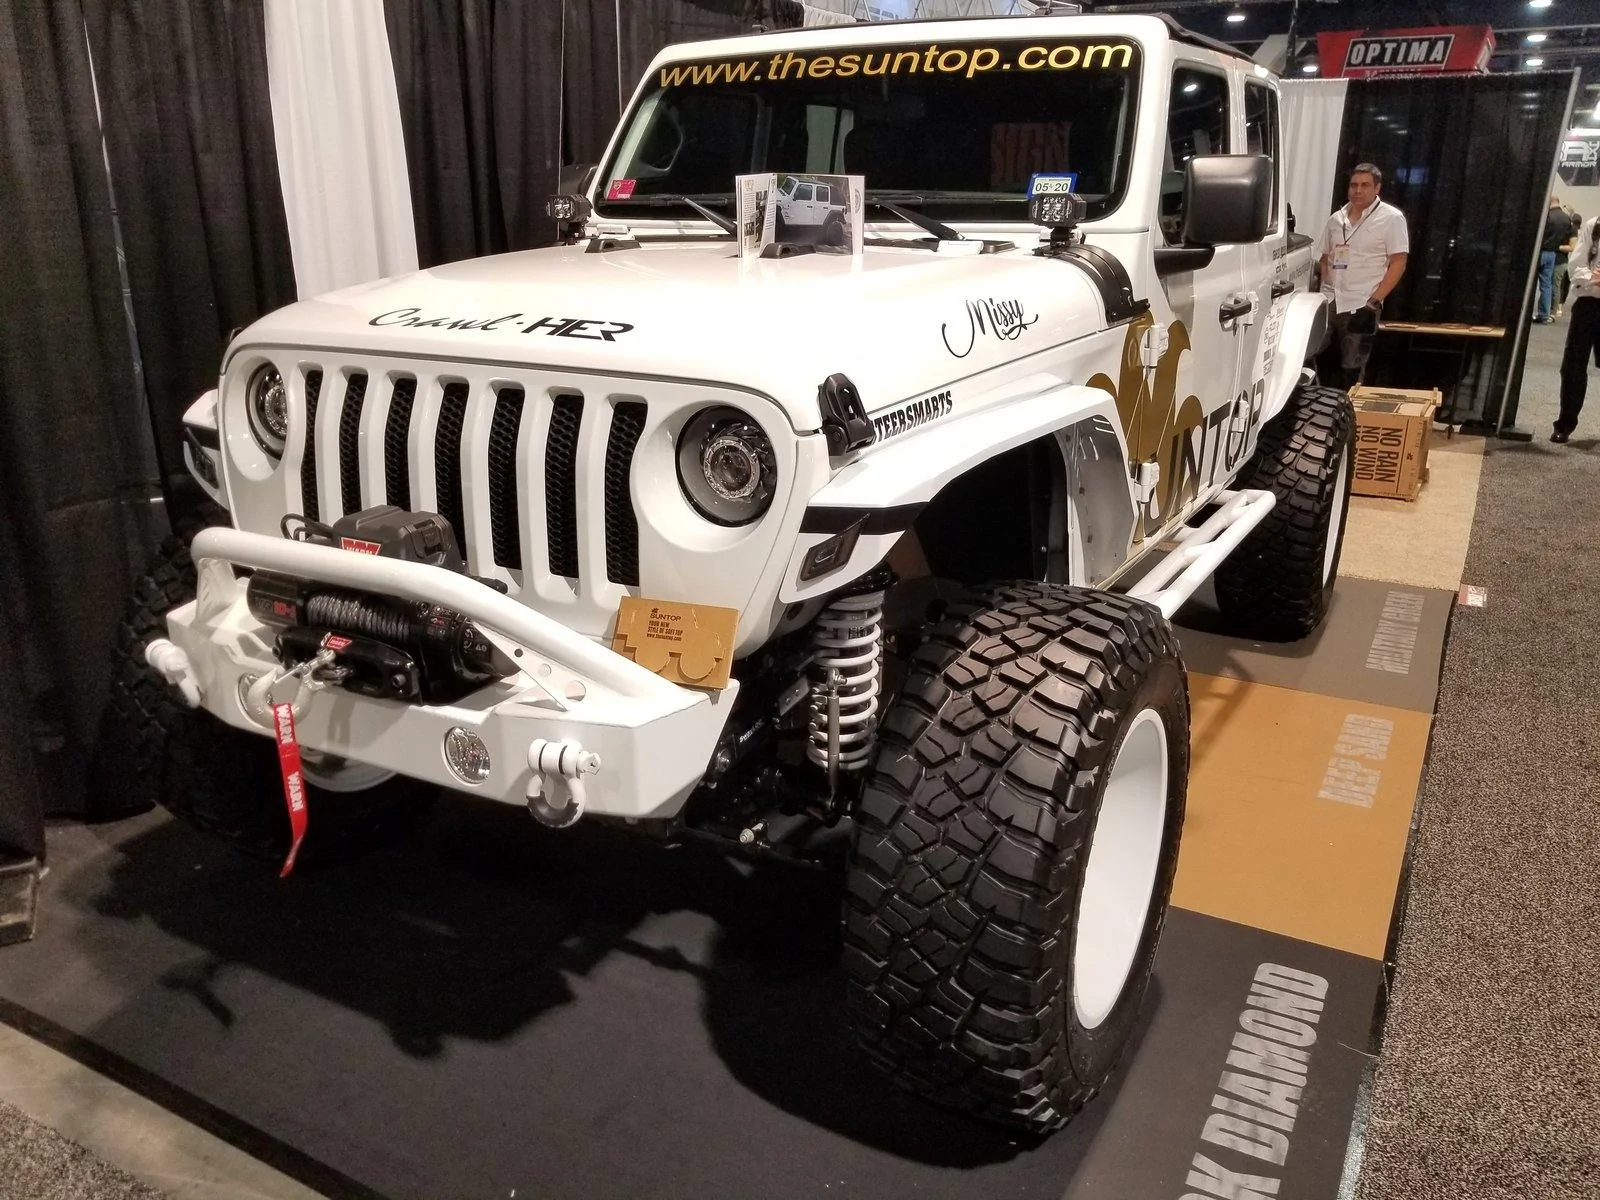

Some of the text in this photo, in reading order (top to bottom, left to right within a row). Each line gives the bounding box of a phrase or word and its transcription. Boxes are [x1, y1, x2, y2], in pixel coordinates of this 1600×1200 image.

[660, 43, 1134, 88] www.thesuntop.com
[1351, 39, 1445, 66] OPTIMA
[1035, 182, 1069, 192] 05 20
[941, 297, 1039, 359] Missy
[872, 389, 954, 443] TEERSMARTS
[1355, 425, 1381, 480] NO WIND
[1379, 427, 1404, 447] NO
[1373, 450, 1400, 483] RAIN
[649, 613, 682, 621] SUNTOP
[275, 704, 296, 744] WARN
[1315, 713, 1395, 809] DEEP SAND
[287, 771, 304, 812] WARN
[1200, 962, 1330, 1167] DIAMOND
